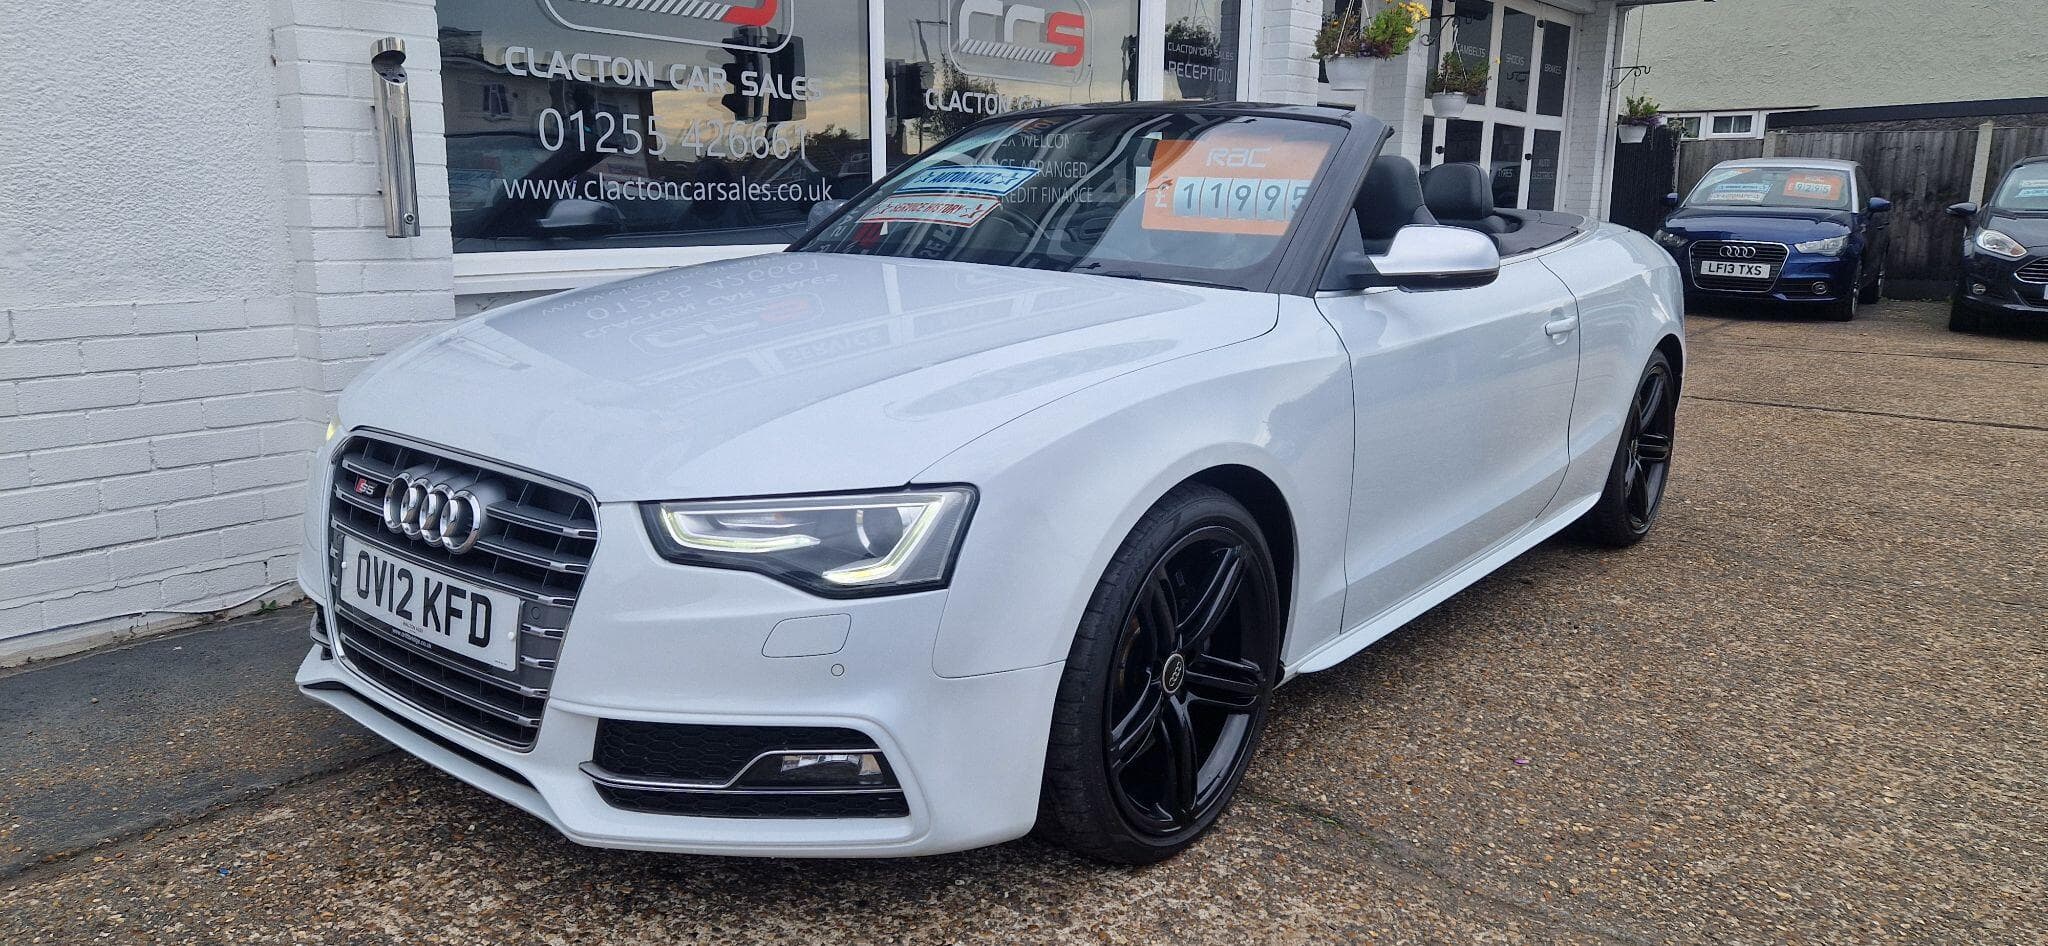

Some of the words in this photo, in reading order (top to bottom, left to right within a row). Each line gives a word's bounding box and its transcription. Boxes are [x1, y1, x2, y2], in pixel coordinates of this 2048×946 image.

[1168, 42, 1197, 55] CLACTON
[1199, 47, 1212, 57] CAR
[1214, 49, 1233, 61] SALES
[505, 46, 654, 87] CLACTON
[670, 64, 727, 91] CAR
[742, 71, 822, 100] SALES
[1168, 61, 1232, 83] RECEPTION
[926, 88, 1009, 114] CLACTON
[539, 107, 666, 156] 01255
[681, 117, 806, 160] 426661
[1206, 145, 1272, 167] RAC
[502, 172, 833, 203] www.clactoncarsales.co.uk
[930, 171, 994, 185] AUTOMATIC
[1042, 187, 1094, 204] FINANCE
[926, 202, 965, 214] HISTORY
[1708, 262, 1736, 275] LF13
[1738, 264, 1762, 276] TXS
[357, 550, 414, 621] OV12
[423, 577, 492, 647] KFD
